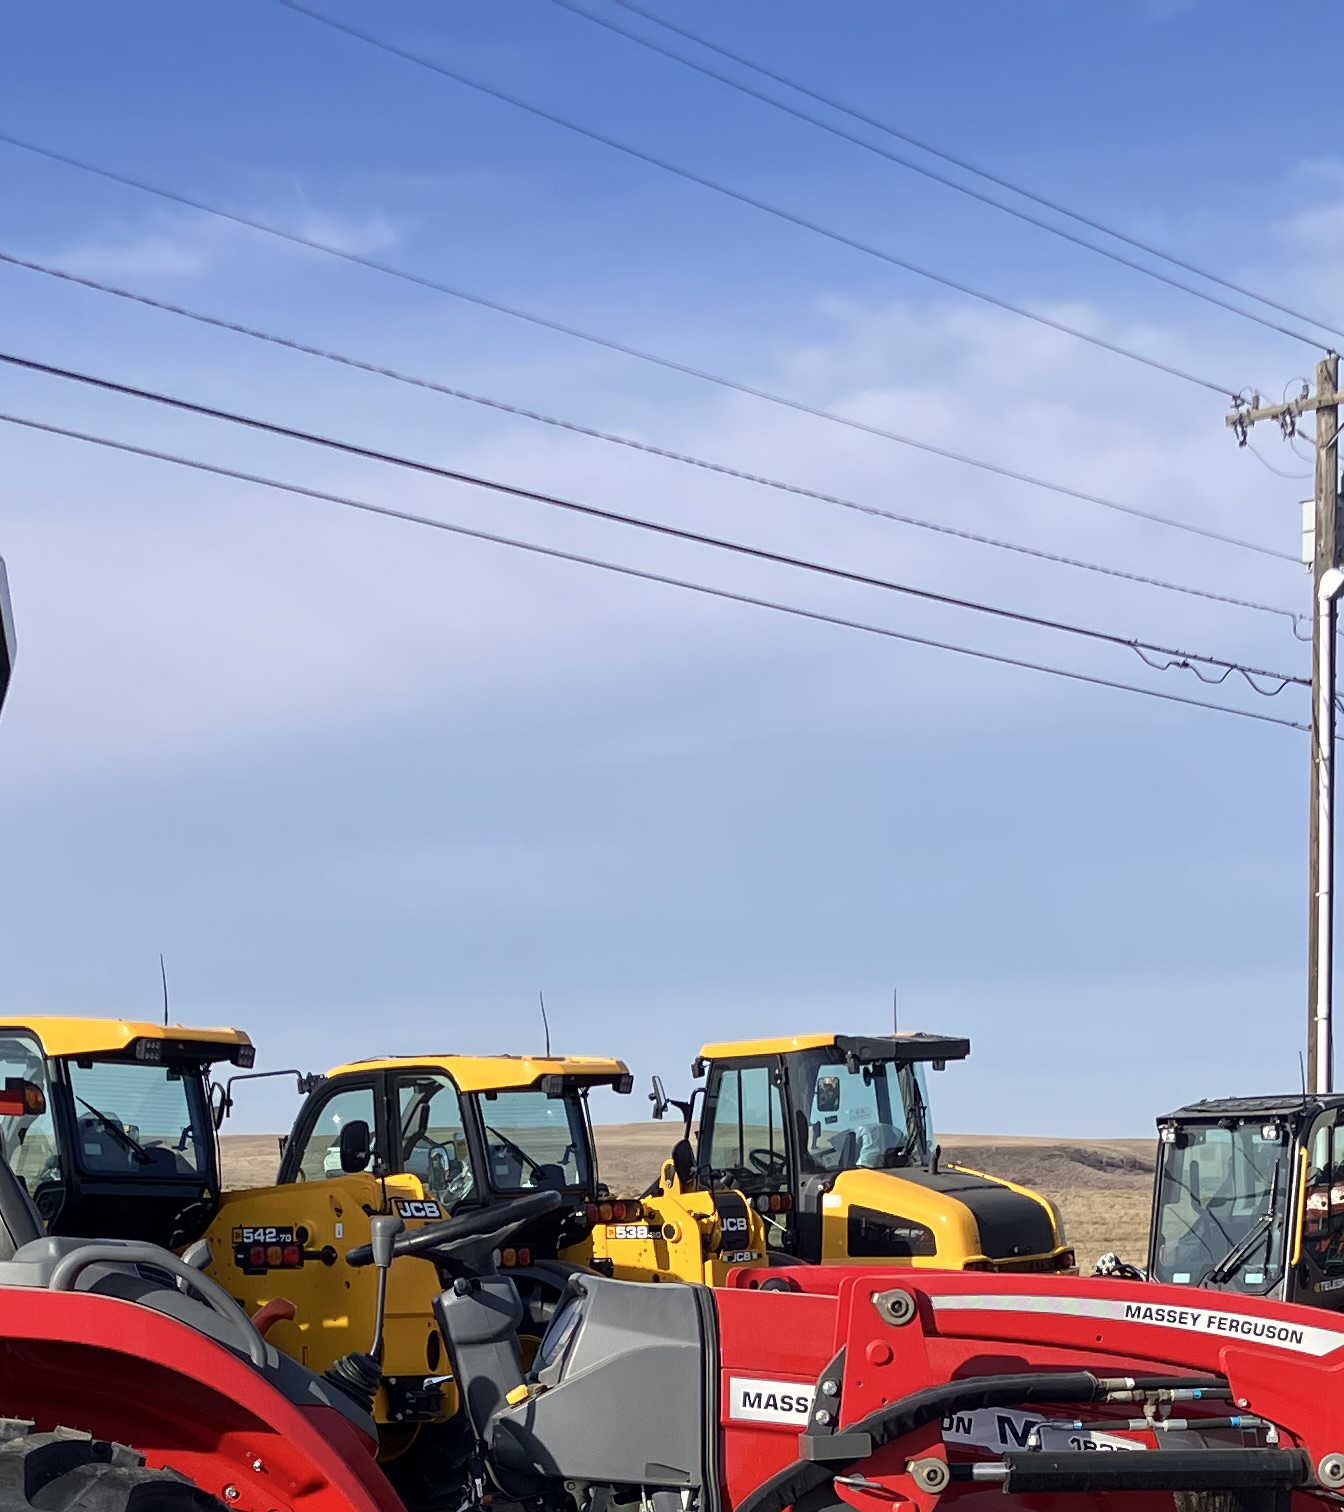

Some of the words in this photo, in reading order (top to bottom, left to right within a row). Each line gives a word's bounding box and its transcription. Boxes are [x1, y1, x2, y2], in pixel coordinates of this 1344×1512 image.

[400, 1201, 440, 1217] JCB
[722, 1217, 747, 1232] JCB
[242, 1227, 293, 1244] 542-70
[732, 1251, 752, 1263] JCB
[1124, 1304, 1202, 1332] MASSEY
[1206, 1315, 1304, 1345] FERGUSON
[742, 1391, 811, 1414] MASS
